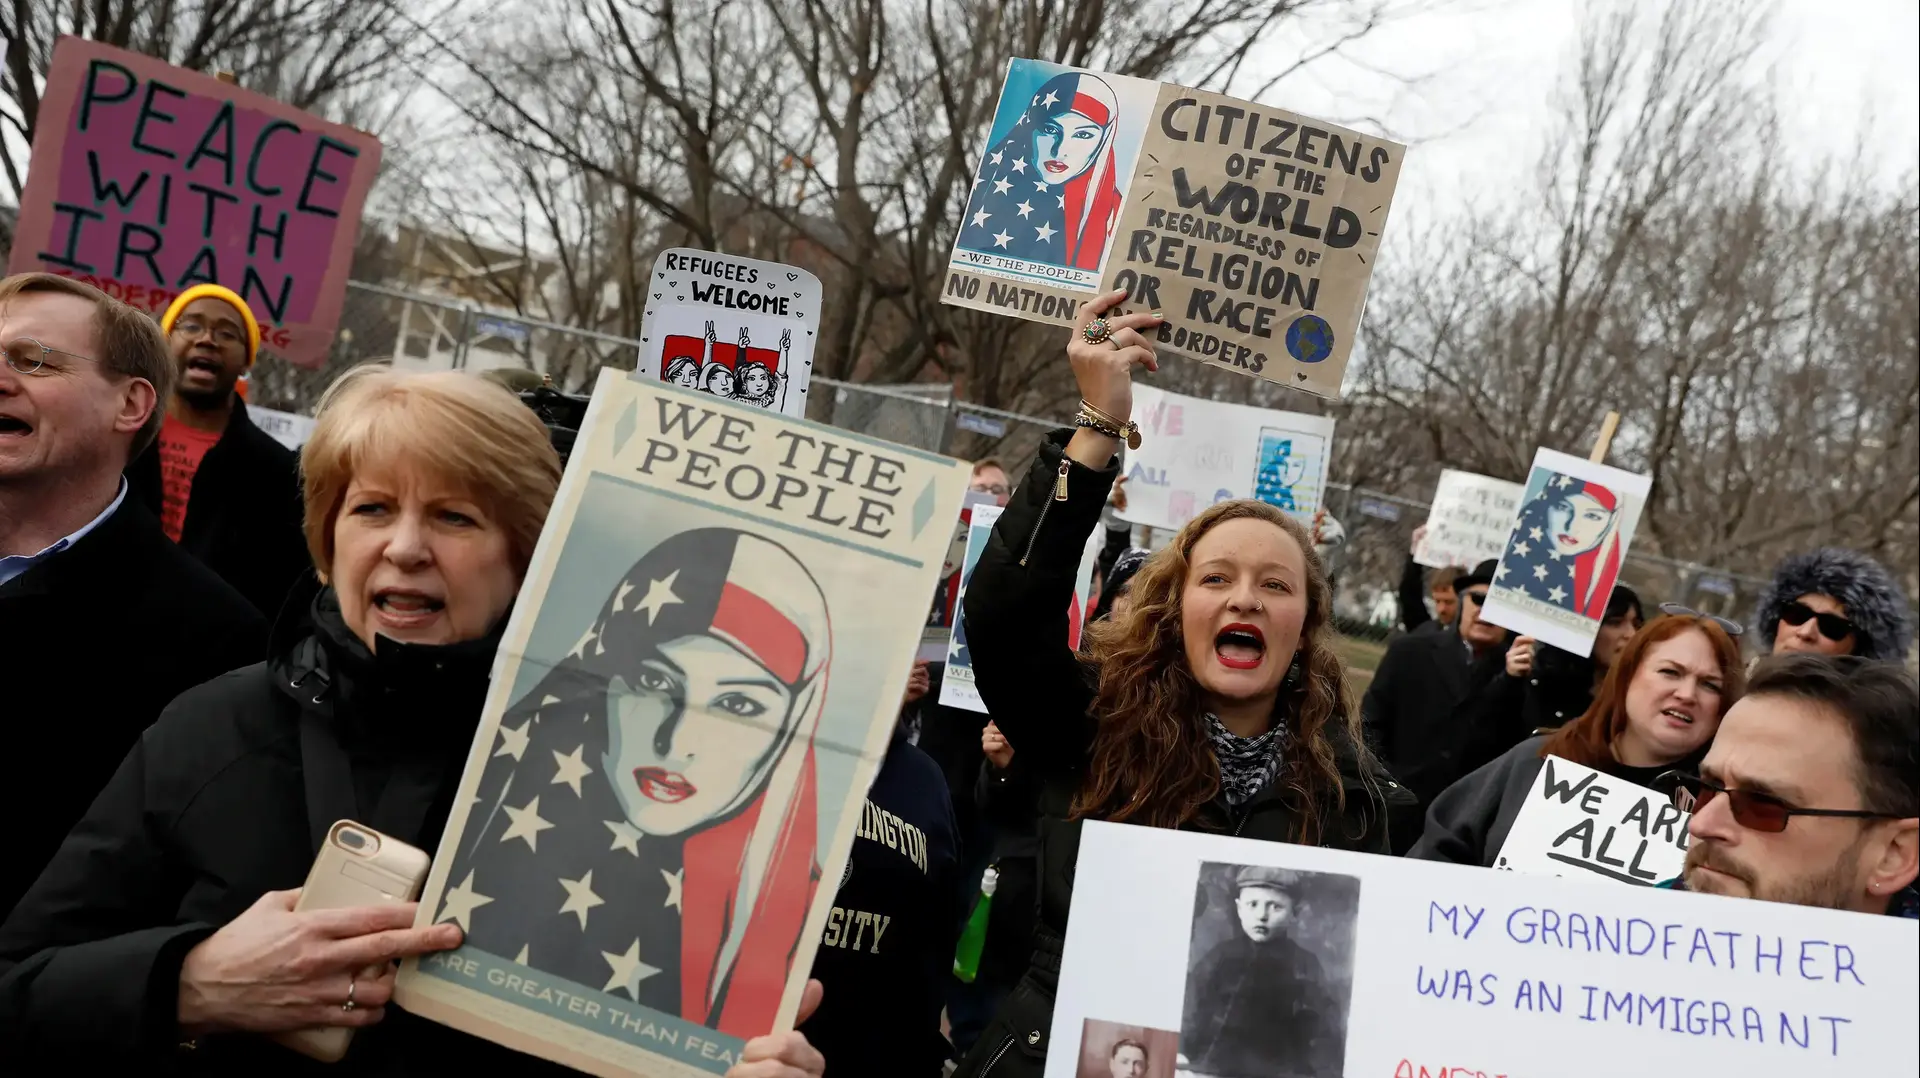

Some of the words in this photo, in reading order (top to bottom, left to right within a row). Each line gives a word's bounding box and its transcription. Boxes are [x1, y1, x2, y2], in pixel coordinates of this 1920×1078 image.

[78, 59, 360, 217] PEACE
[1160, 98, 1389, 183] CITIZENS
[87, 150, 288, 260] WITH
[1226, 153, 1265, 181] OF
[1273, 162, 1326, 196] THE
[1147, 208, 1286, 260] REGARDLESS
[1295, 247, 1321, 267] OF
[1172, 167, 1362, 248] WORLD
[38, 202, 293, 325] IRAN
[666, 253, 758, 283] REFUGEES
[947, 273, 980, 300] NO
[969, 253, 991, 265] WE
[996, 258, 1023, 271] THE
[1028, 264, 1083, 282] PEOPLE
[1127, 229, 1320, 311] RELIGION
[692, 281, 789, 315] WELCOME
[1113, 269, 1161, 310] OR
[1186, 288, 1276, 339] RACE
[1157, 320, 1267, 373] BORDERS
[654, 397, 755, 455] WE
[775, 430, 906, 497] THE
[1142, 401, 1184, 436] WE
[636, 438, 896, 539] PEOPLE
[1127, 461, 1171, 487] ALL
[950, 667, 972, 679] WE
[1544, 759, 1609, 815] WE
[1552, 818, 1657, 879] ALL
[819, 907, 891, 954] SITY
[1428, 900, 1485, 940] MY
[1506, 906, 1866, 986] GRANDFATHER
[429, 953, 477, 977] ARE
[487, 969, 601, 1020] GREATER
[608, 1007, 678, 1045] THAN
[1417, 965, 1498, 1005] WAS
[1515, 978, 1562, 1013] AN
[1579, 985, 1852, 1056] IMMIGRANT
